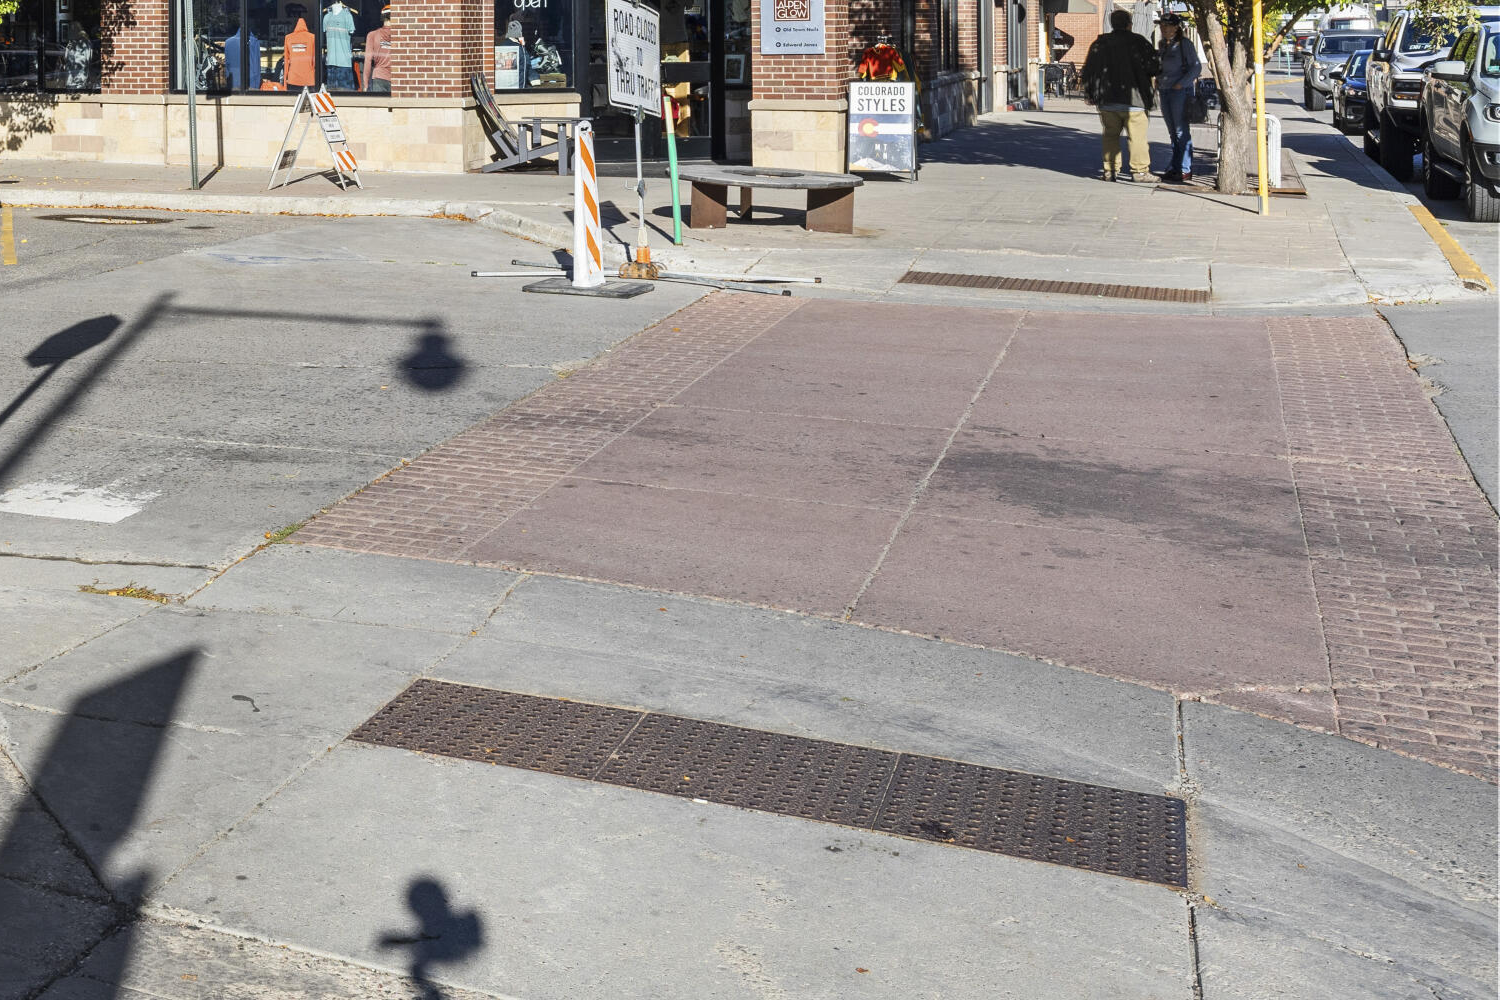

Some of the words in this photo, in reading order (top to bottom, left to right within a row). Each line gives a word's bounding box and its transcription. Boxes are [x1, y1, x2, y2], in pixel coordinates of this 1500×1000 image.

[776, 0, 807, 9] ALPEN
[777, 9, 807, 19] GLOW
[613, 9, 634, 36] ROAD
[636, 15, 657, 45] CLOSED
[636, 47, 643, 66] TO
[615, 69, 636, 96] THRU
[858, 86, 905, 96] COLORADO
[857, 99, 905, 112] STYLES
